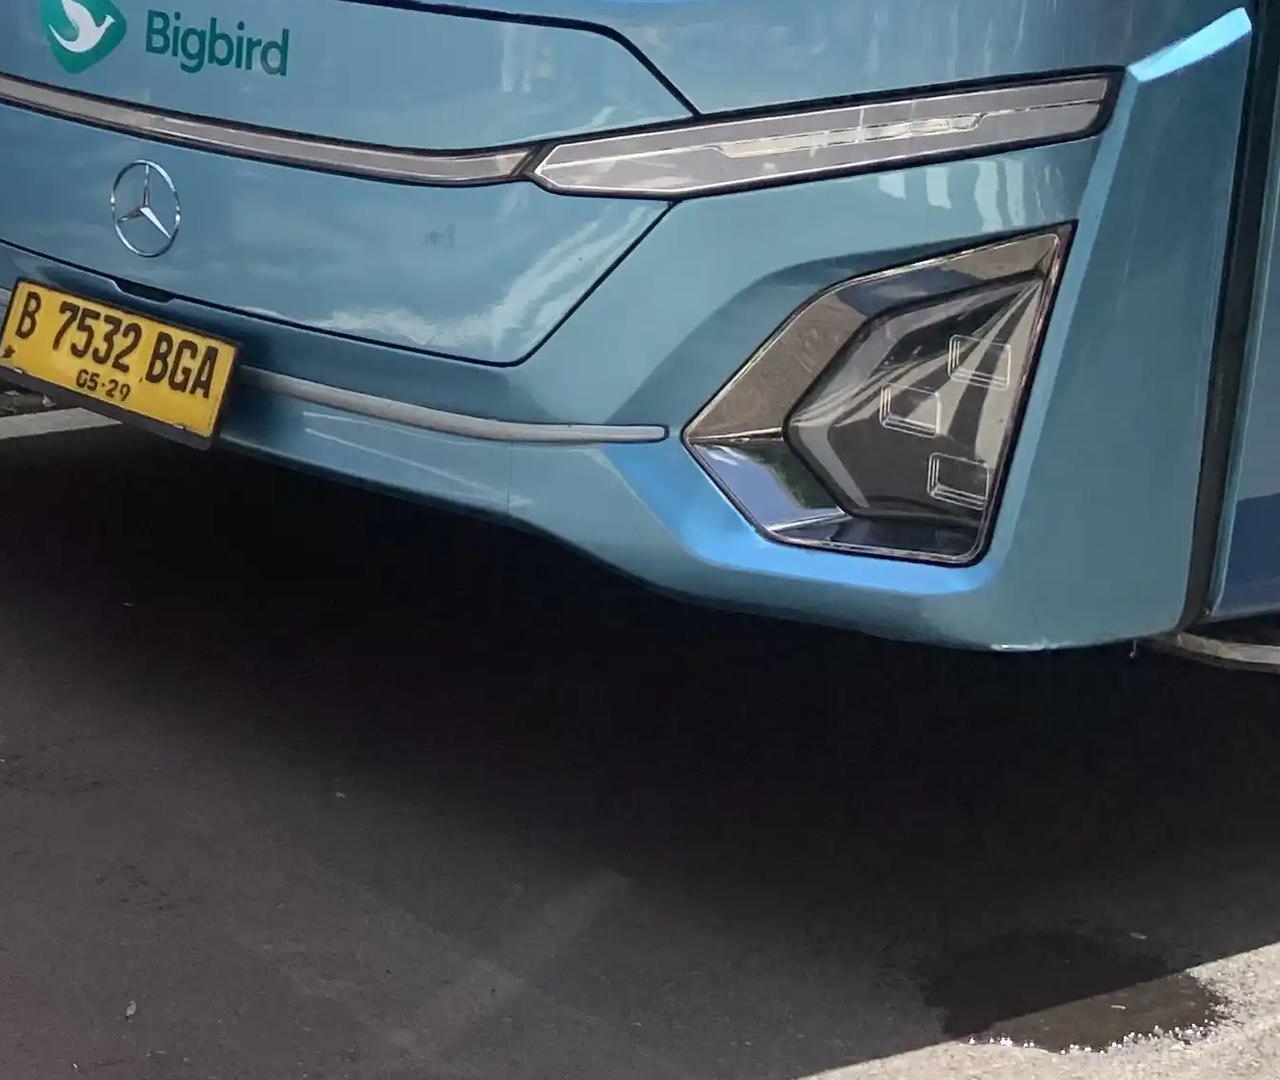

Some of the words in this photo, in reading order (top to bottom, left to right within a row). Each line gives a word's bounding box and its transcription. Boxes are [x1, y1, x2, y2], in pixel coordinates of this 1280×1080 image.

[146, 9, 290, 77] Bigbird
[15, 291, 42, 340] B
[52, 300, 143, 373] 7532
[145, 330, 220, 399] BGA
